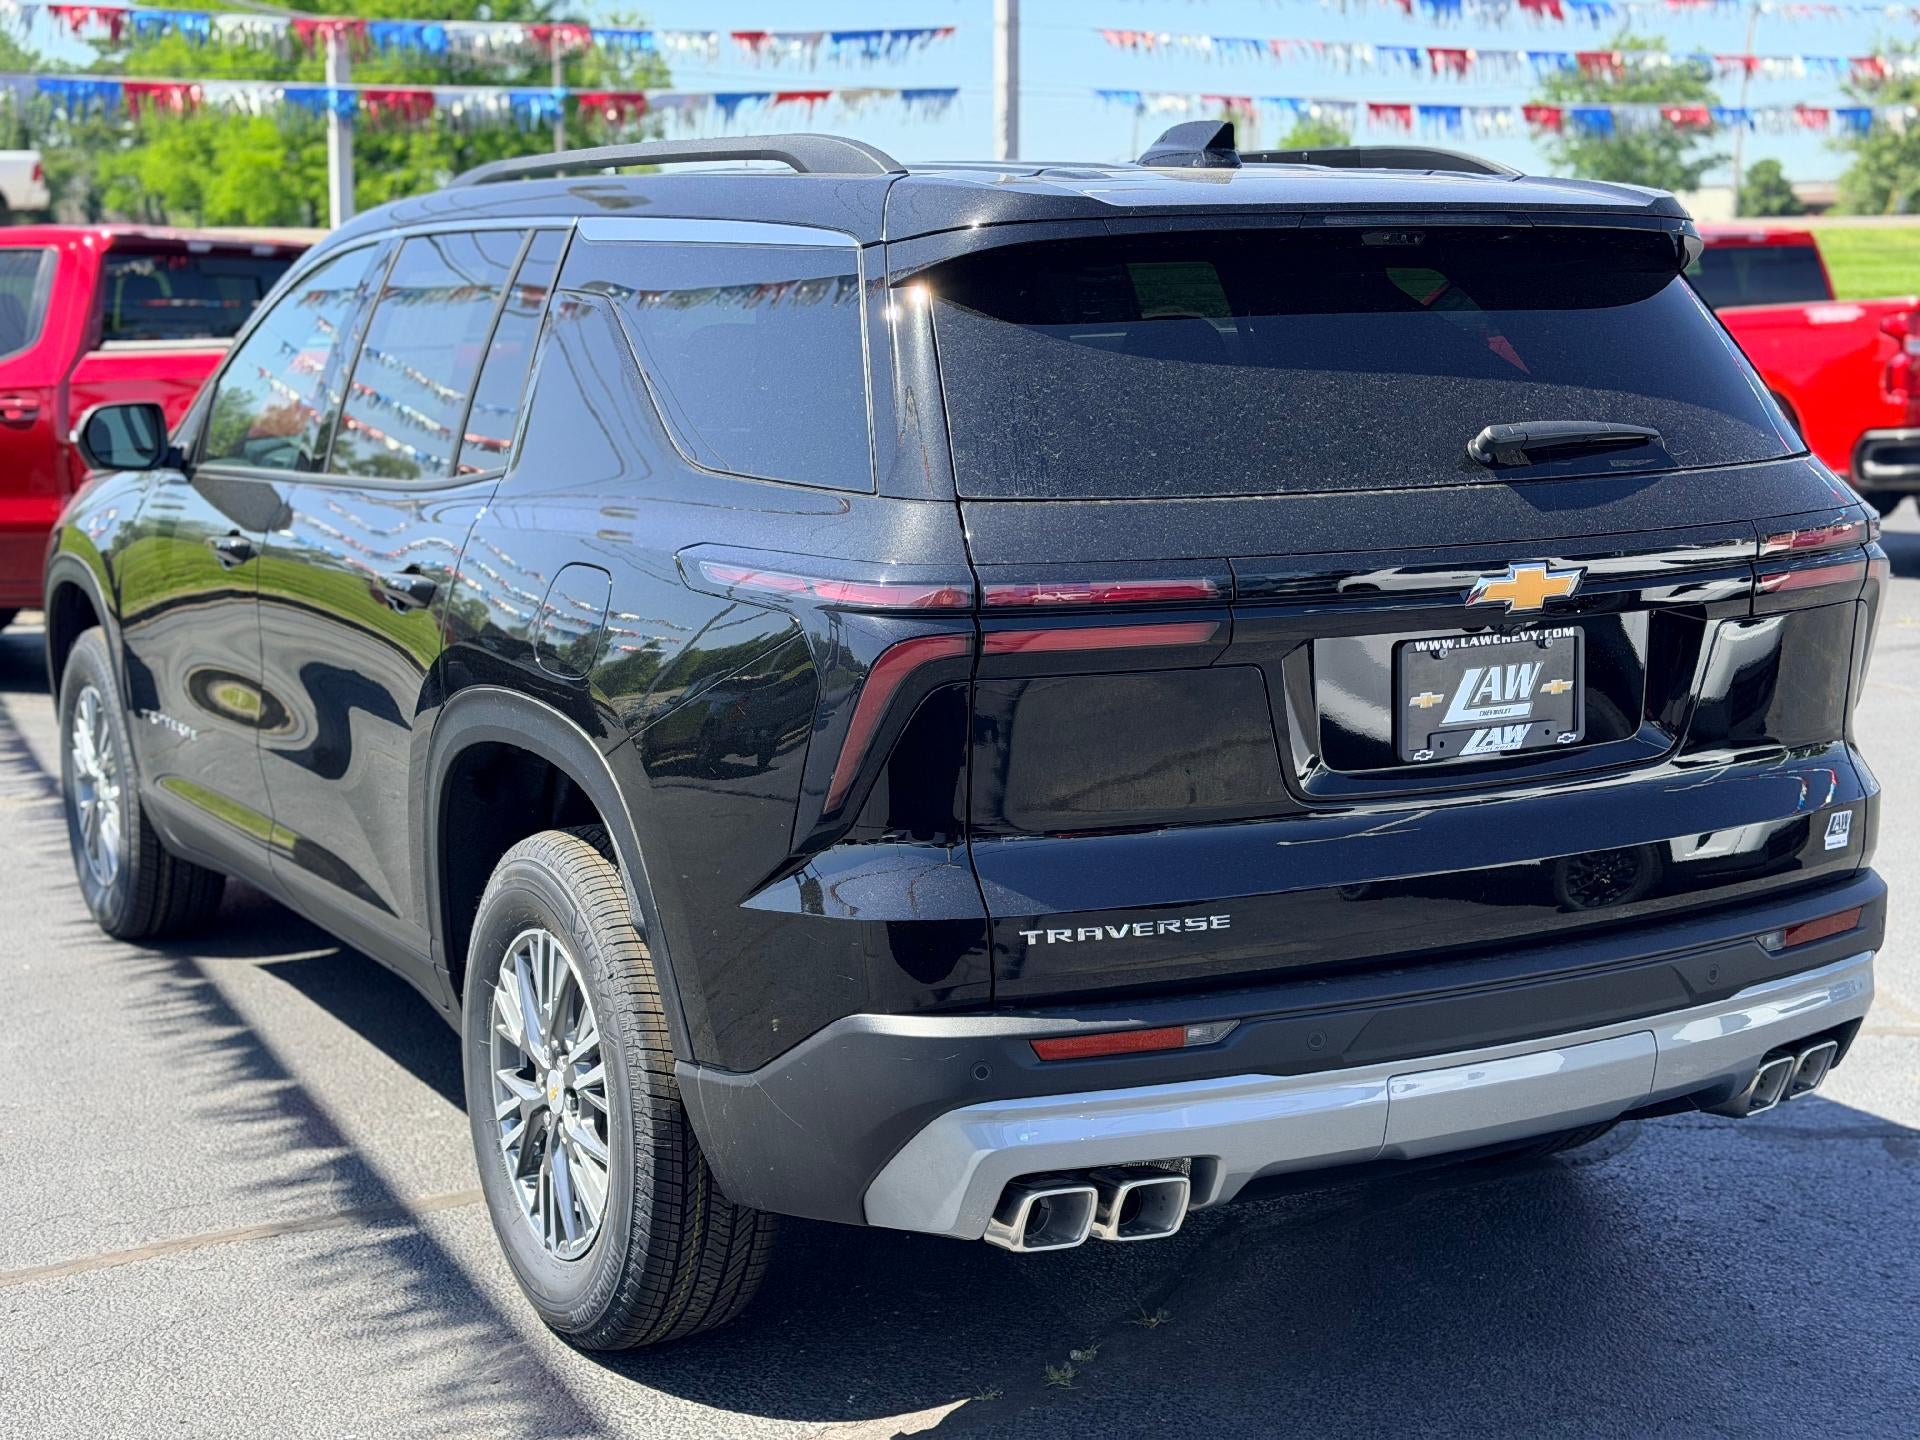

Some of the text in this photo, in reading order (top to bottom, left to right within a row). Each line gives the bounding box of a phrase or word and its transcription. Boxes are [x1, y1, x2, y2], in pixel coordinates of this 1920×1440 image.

[1415, 627, 1574, 651] WWW.LAWCHEVY.COM
[1440, 661, 1544, 726] LAW
[1459, 723, 1533, 756] LAW
[1019, 914, 1231, 946] TRAVERSE
